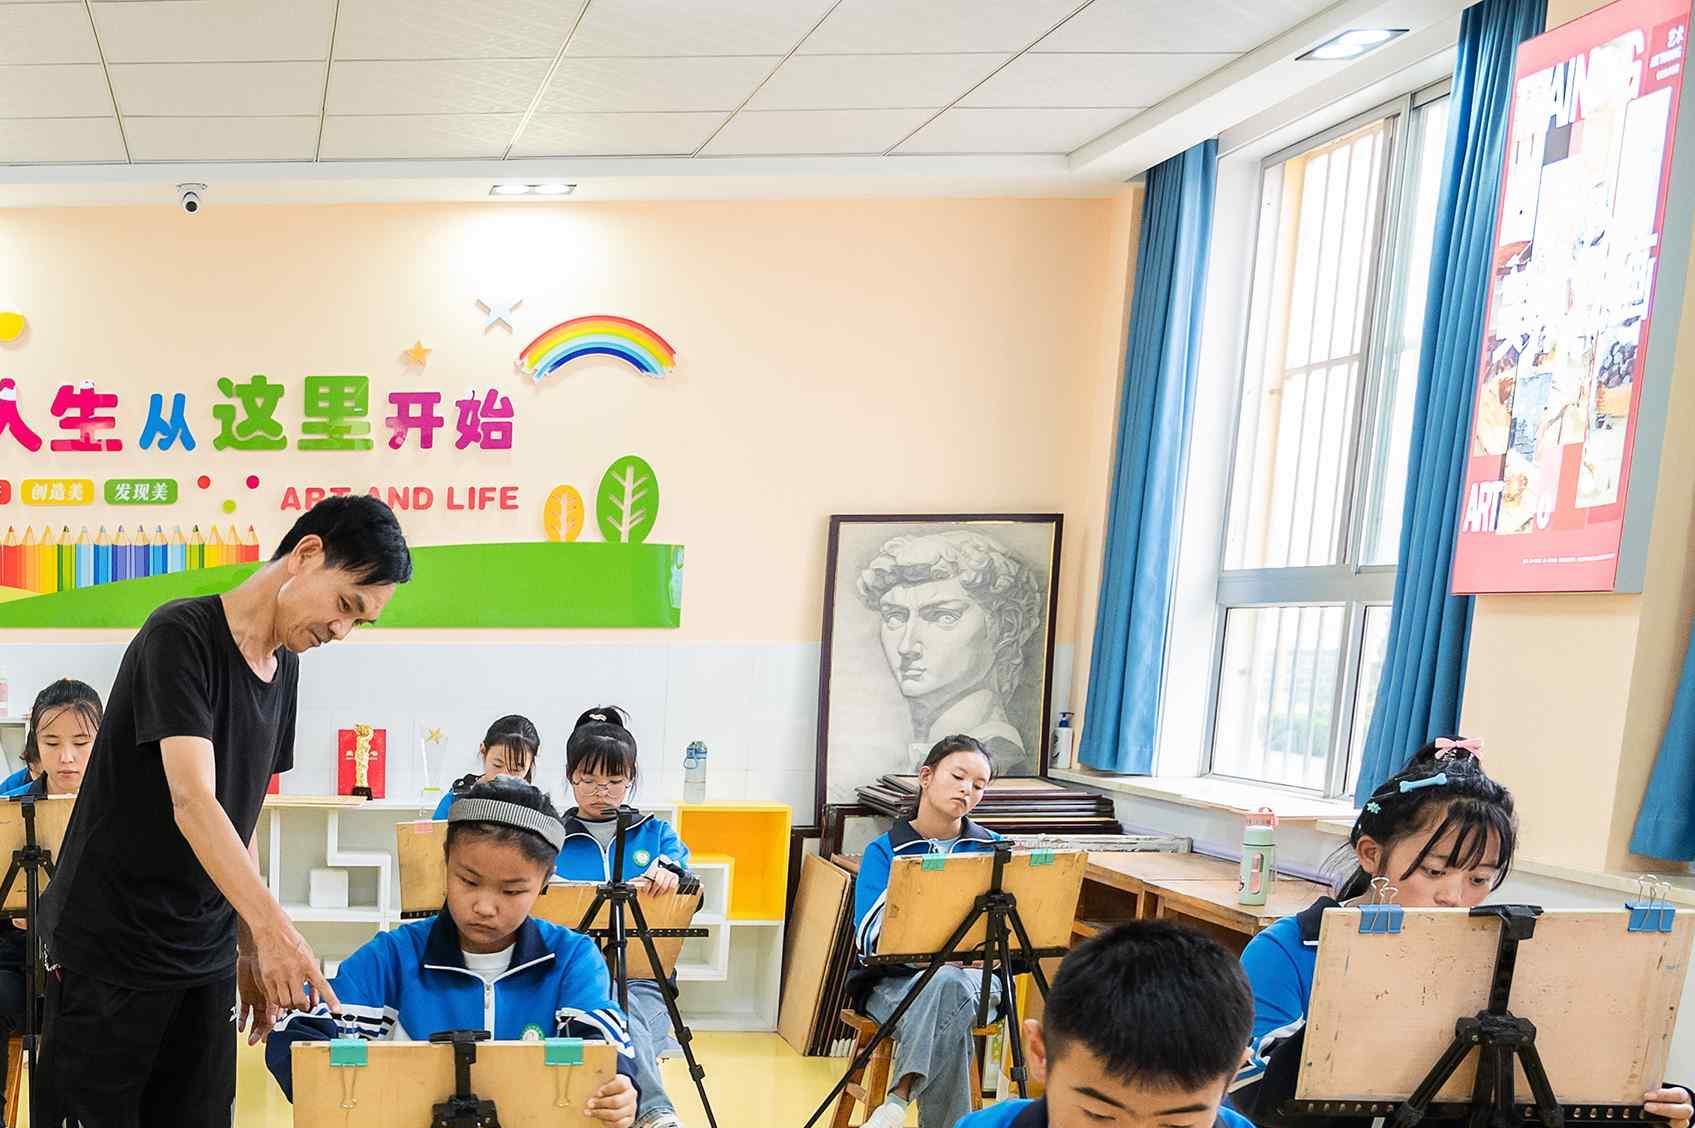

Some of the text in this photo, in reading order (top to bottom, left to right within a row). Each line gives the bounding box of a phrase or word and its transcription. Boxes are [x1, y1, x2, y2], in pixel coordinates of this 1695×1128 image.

[31, 483, 84, 502] 创造美
[114, 482, 169, 502] 发现美
[447, 486, 519, 510] LIFE
